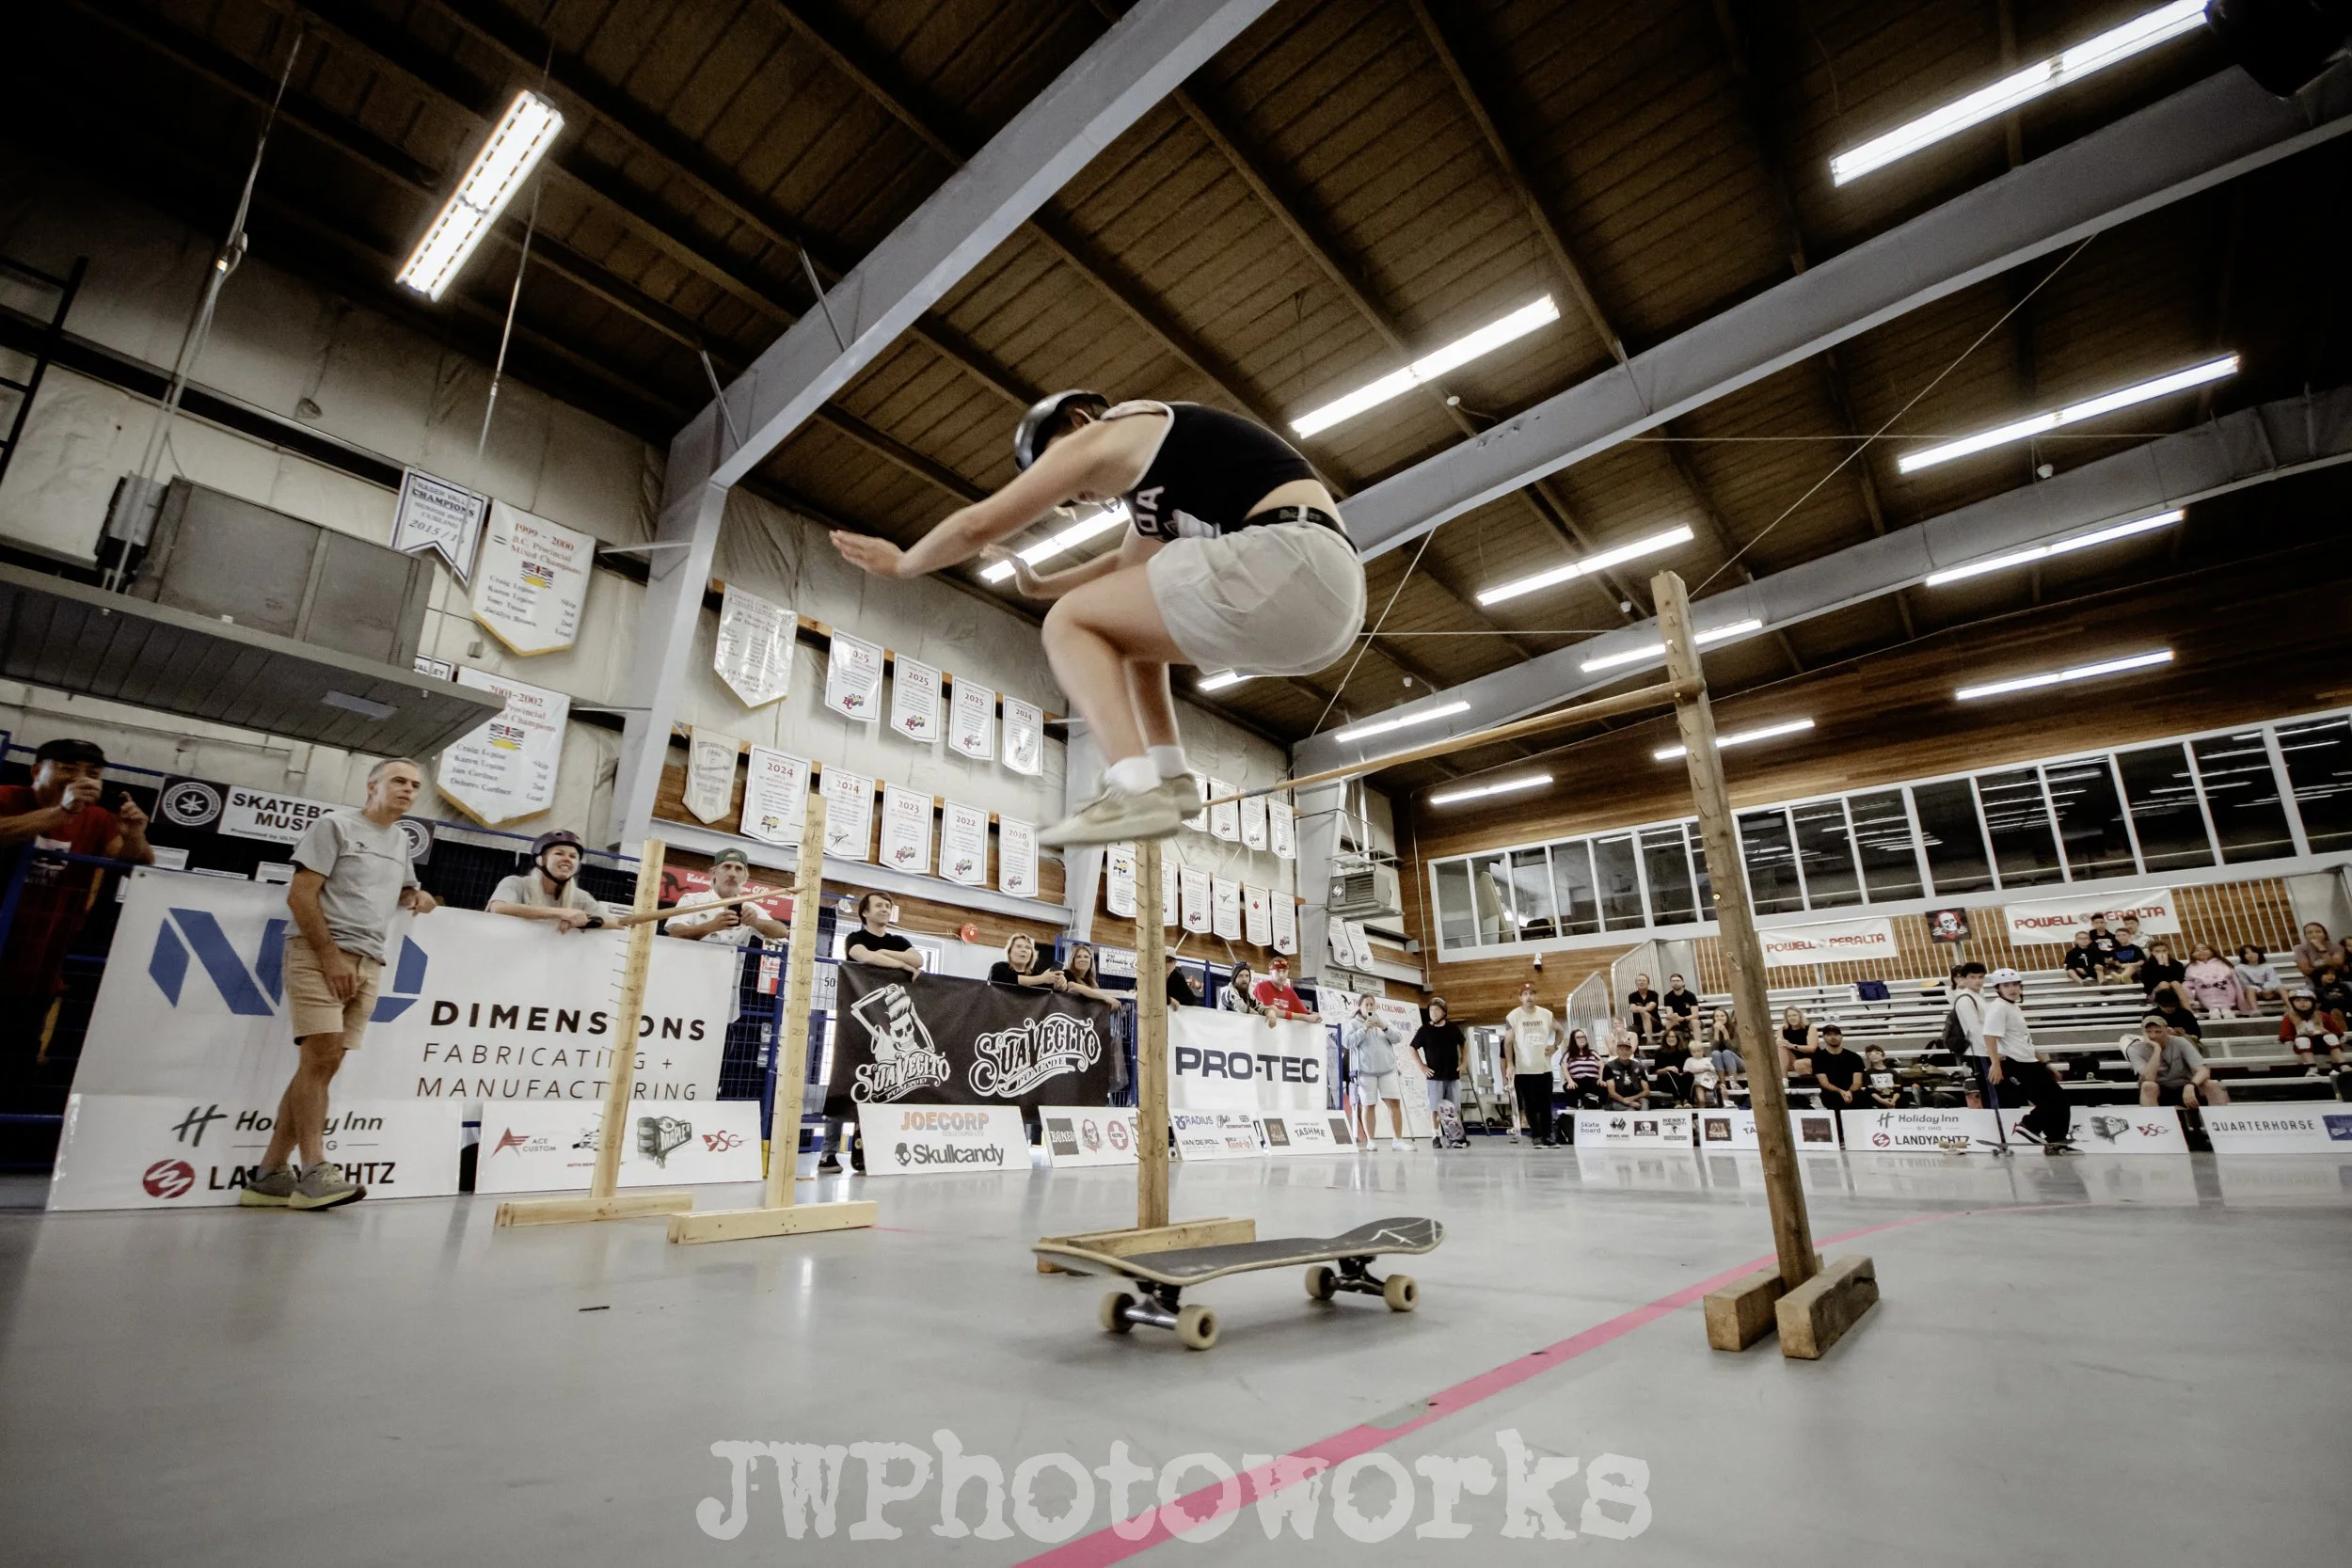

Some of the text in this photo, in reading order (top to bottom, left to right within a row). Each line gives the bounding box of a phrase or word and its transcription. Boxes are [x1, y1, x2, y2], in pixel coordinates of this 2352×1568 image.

[447, 493, 476, 508] VALLY
[515, 522, 539, 537] 1999
[551, 535, 575, 551] 2000
[510, 545, 537, 560] Mixed
[532, 542, 572, 562] Provincial
[850, 650, 869, 663] 025
[415, 660, 445, 676] ALEY
[908, 671, 930, 687] 2025
[964, 692, 984, 706] 2025
[1015, 708, 1032, 722] 2024
[767, 762, 794, 778] 2024
[835, 780, 860, 794] 2024
[898, 800, 920, 814] 2023
[956, 815, 976, 827] 2022
[1009, 828, 1027, 840] 2020
[2014, 914, 2078, 929] POWELL
[1766, 932, 1886, 953] POWELL PERALTA
[823, 976, 836, 988] 50
[430, 999, 707, 1042] DIMENSONS
[968, 1012, 1103, 1098] SUAVECITO
[850, 1051, 952, 1104] SUAVECITO
[416, 1076, 697, 1101] MANUFACTRING
[345, 1110, 384, 1131] Inn
[900, 1110, 991, 1132] JOECORP
[1185, 1115, 1214, 1126] RADIUS
[1898, 1114, 1940, 1124] Holiday
[1941, 1114, 1960, 1123] Inn
[2211, 1119, 2315, 1132] QUARTERHORSE
[1294, 1127, 1326, 1138] TASHME
[913, 1143, 1005, 1166] Skullcandy
